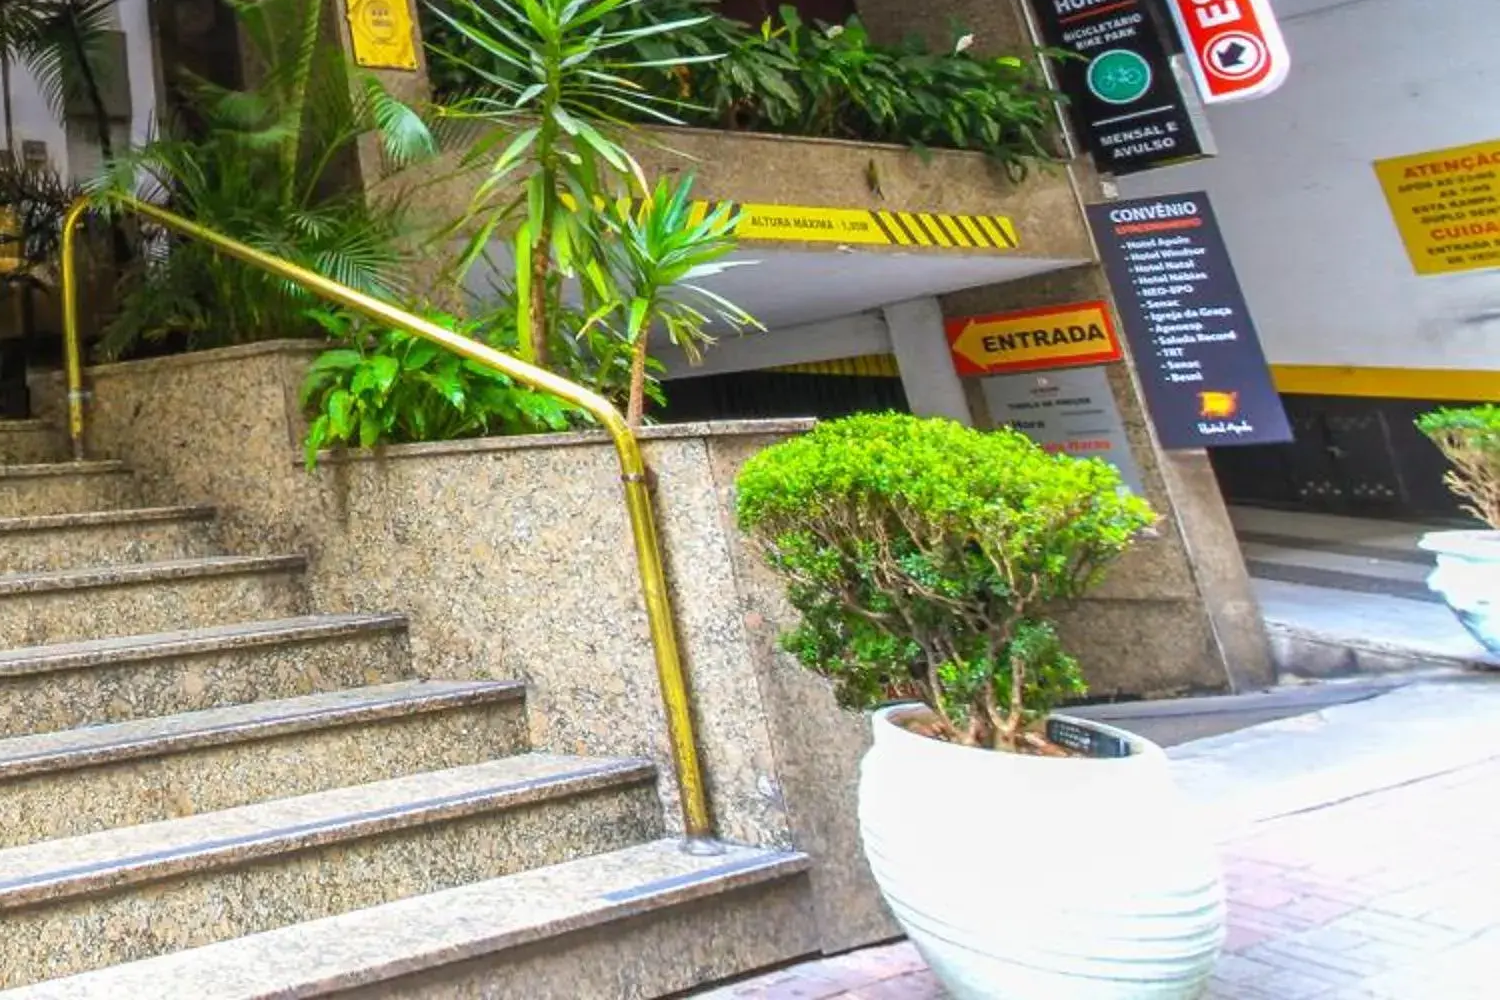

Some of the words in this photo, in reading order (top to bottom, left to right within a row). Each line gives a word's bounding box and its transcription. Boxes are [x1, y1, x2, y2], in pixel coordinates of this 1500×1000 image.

[1076, 36, 1105, 51] BIKE
[1104, 27, 1137, 45] PARK
[1100, 124, 1165, 147] MENSAL
[1167, 121, 1179, 132] E
[1112, 137, 1176, 159] AVULSO
[751, 215, 791, 228] ALTURA
[982, 323, 1106, 353] ENTRADA
